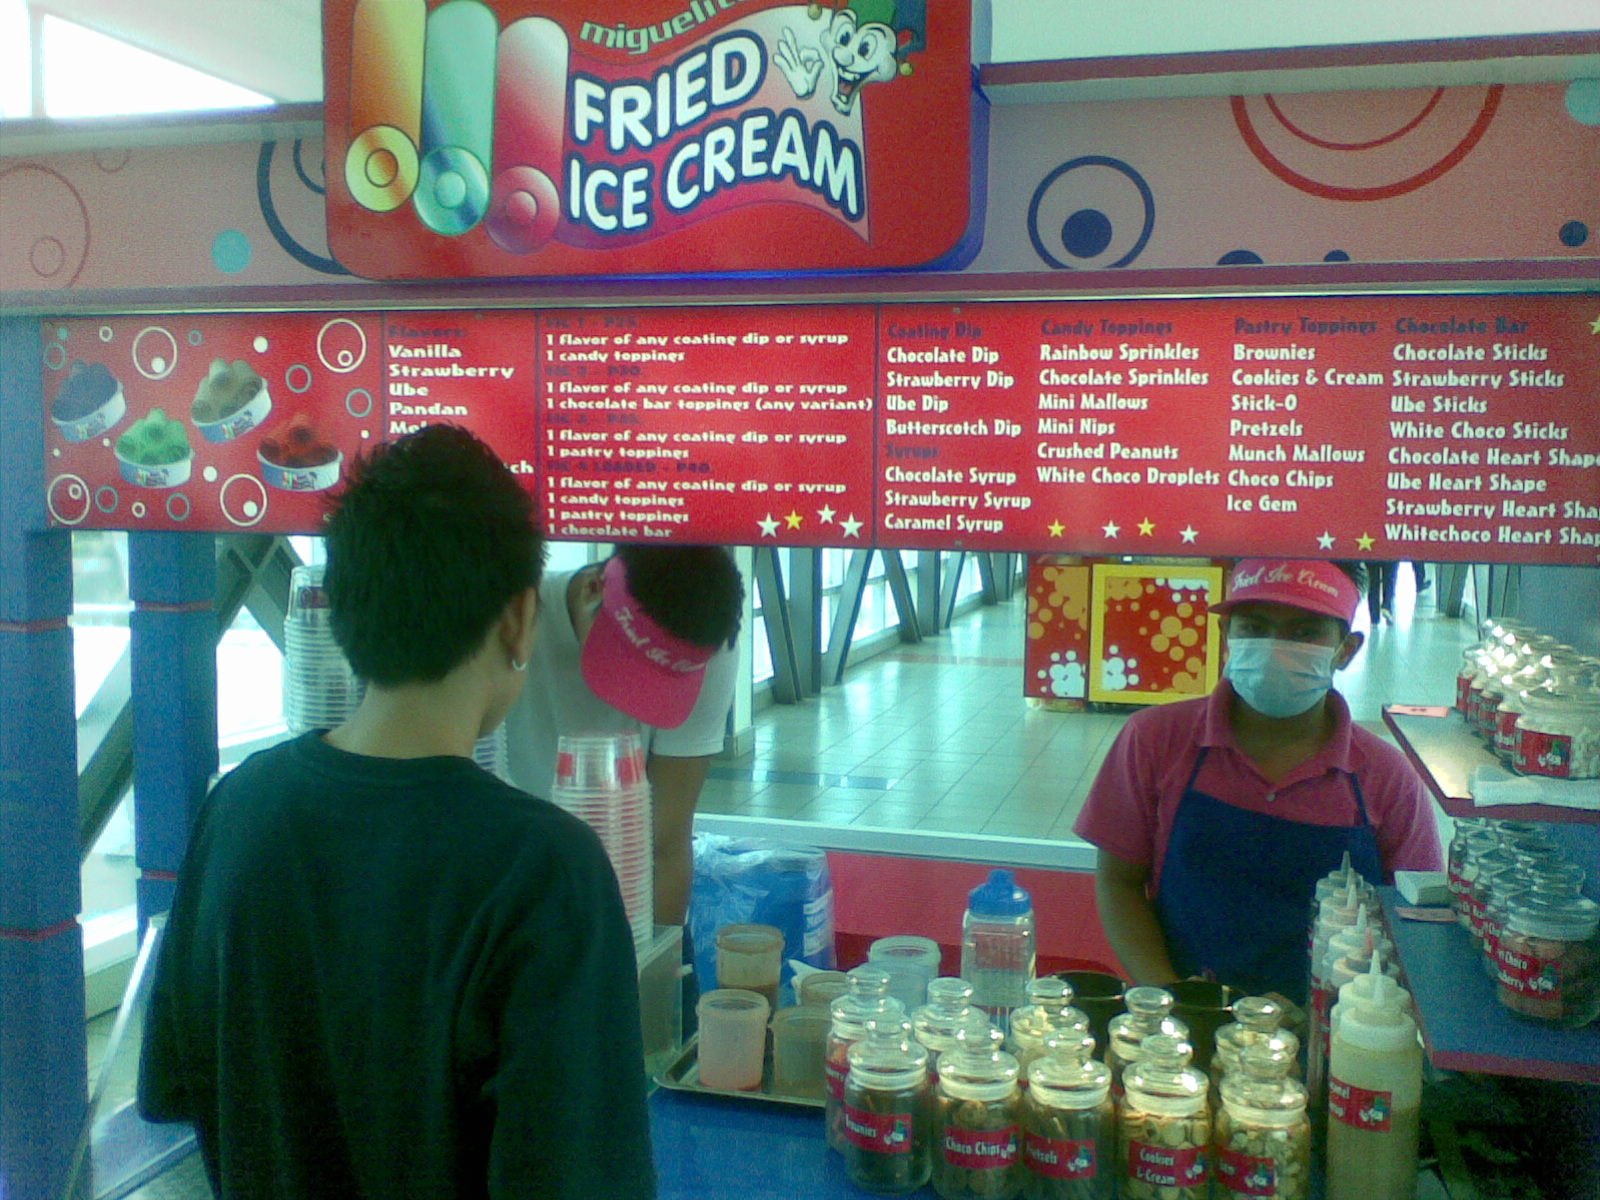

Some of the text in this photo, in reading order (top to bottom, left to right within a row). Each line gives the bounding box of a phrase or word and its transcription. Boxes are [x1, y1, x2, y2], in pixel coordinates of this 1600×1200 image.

[580, 0, 736, 54] migueli
[571, 33, 765, 153] FRIED
[568, 112, 860, 233] ICE CREAM
[1042, 319, 1173, 336] Candy Toppings
[1235, 317, 1377, 335] Pastry Toppings
[1396, 318, 1529, 334] Chocolate Bar
[548, 335, 553, 345] 1
[560, 334, 608, 345] flavor
[614, 334, 631, 344] of
[636, 337, 668, 346] any
[674, 333, 737, 346] coating
[742, 333, 769, 345] dip
[800, 335, 848, 344] syrup
[389, 344, 461, 358] Vanilla
[547, 350, 684, 362] 1 candy toppings
[888, 346, 999, 364] Chocolate Dip
[1040, 343, 1199, 362] Rainbow Sprinkles
[1234, 344, 1315, 360] Brownies
[1393, 344, 1547, 360] Chocolate Sticks
[389, 364, 514, 378] Strawberry
[1040, 368, 1208, 386] Chocolate Sprinkles
[1233, 368, 1383, 385] Cookies & Cream
[1393, 369, 1564, 389] Strawberry Sticks
[547, 382, 553, 392] 1
[560, 382, 608, 393] flavor
[614, 382, 631, 393] of
[636, 385, 668, 394] any
[674, 382, 736, 395] coating
[742, 382, 768, 394] dip
[800, 385, 847, 394] syrup
[887, 371, 1014, 389] Strawberry Dip
[390, 383, 428, 396] Ube
[390, 402, 467, 415] Pandan
[547, 398, 872, 411] 1 chocolate bar toppings (any variant)
[887, 395, 948, 413] Ube Dip
[1039, 393, 1148, 409] Mini Mallows
[1232, 394, 1297, 410] Stick-O
[1391, 396, 1487, 413] Ube Sticks
[887, 419, 1021, 437] Butterscotch Dip
[1038, 418, 1115, 436] Mini Nips
[1231, 419, 1302, 436] Pretzels
[1390, 421, 1568, 440] White Choco Sticks
[548, 430, 846, 444] 1 flavor of any coating dip or syrup
[548, 445, 688, 459] 1 pastry toppings
[1038, 442, 1178, 459] Crushed Peanuts
[1229, 444, 1365, 462] Munch Mallows
[1389, 447, 1479, 464] Chocolate
[1487, 448, 1541, 465] Heart
[886, 466, 1016, 485] Chocolate Syrup
[1037, 467, 1219, 486] White Choco Droplets
[1228, 469, 1333, 488] Choco Chips
[1388, 472, 1546, 493] Ube Heart Shape
[549, 477, 846, 493] 1 flavor of any coating dip or syrup
[549, 493, 684, 507] 1 candy toppings
[885, 490, 1031, 509] Strawberry Syrup
[1228, 495, 1297, 511] Ice Gem
[549, 509, 688, 523] 1 pastry toppings
[1387, 498, 1495, 519] Strawberry
[1503, 500, 1555, 517] Heart
[550, 524, 672, 537] 1 chocolate bar
[885, 513, 1003, 532] Caramel Syrup
[1385, 524, 1491, 542] Whitechoco
[1498, 526, 1551, 543] Heart
